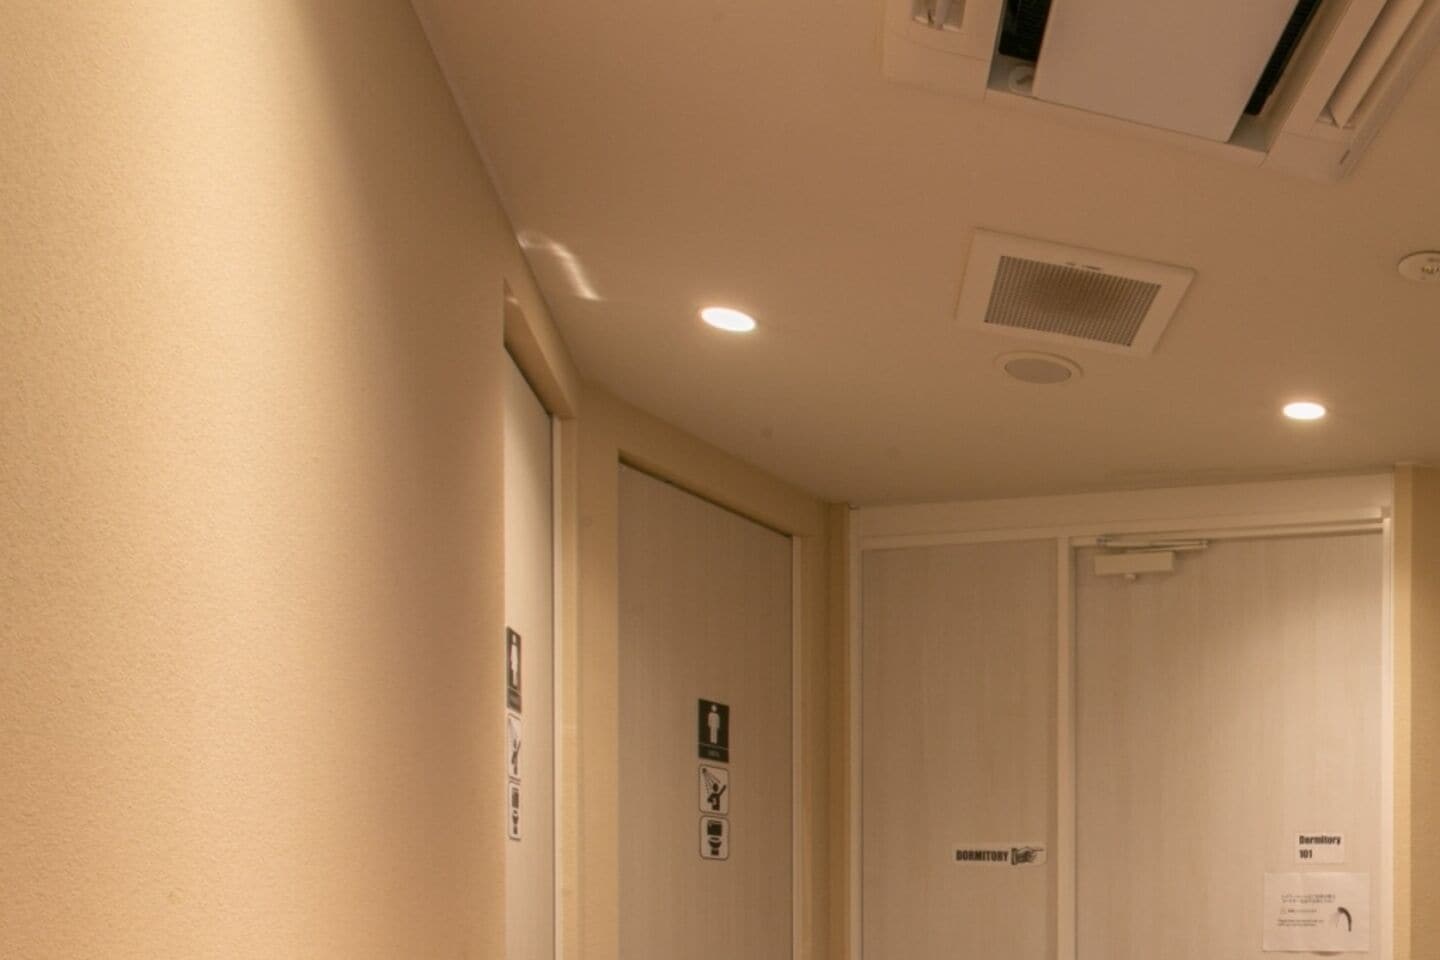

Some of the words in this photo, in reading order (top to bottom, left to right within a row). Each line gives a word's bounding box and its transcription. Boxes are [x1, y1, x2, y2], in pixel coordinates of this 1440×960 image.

[1299, 835, 1342, 846] Dormitory
[956, 849, 1009, 862] DORMITORY
[1299, 849, 1313, 859] 101
